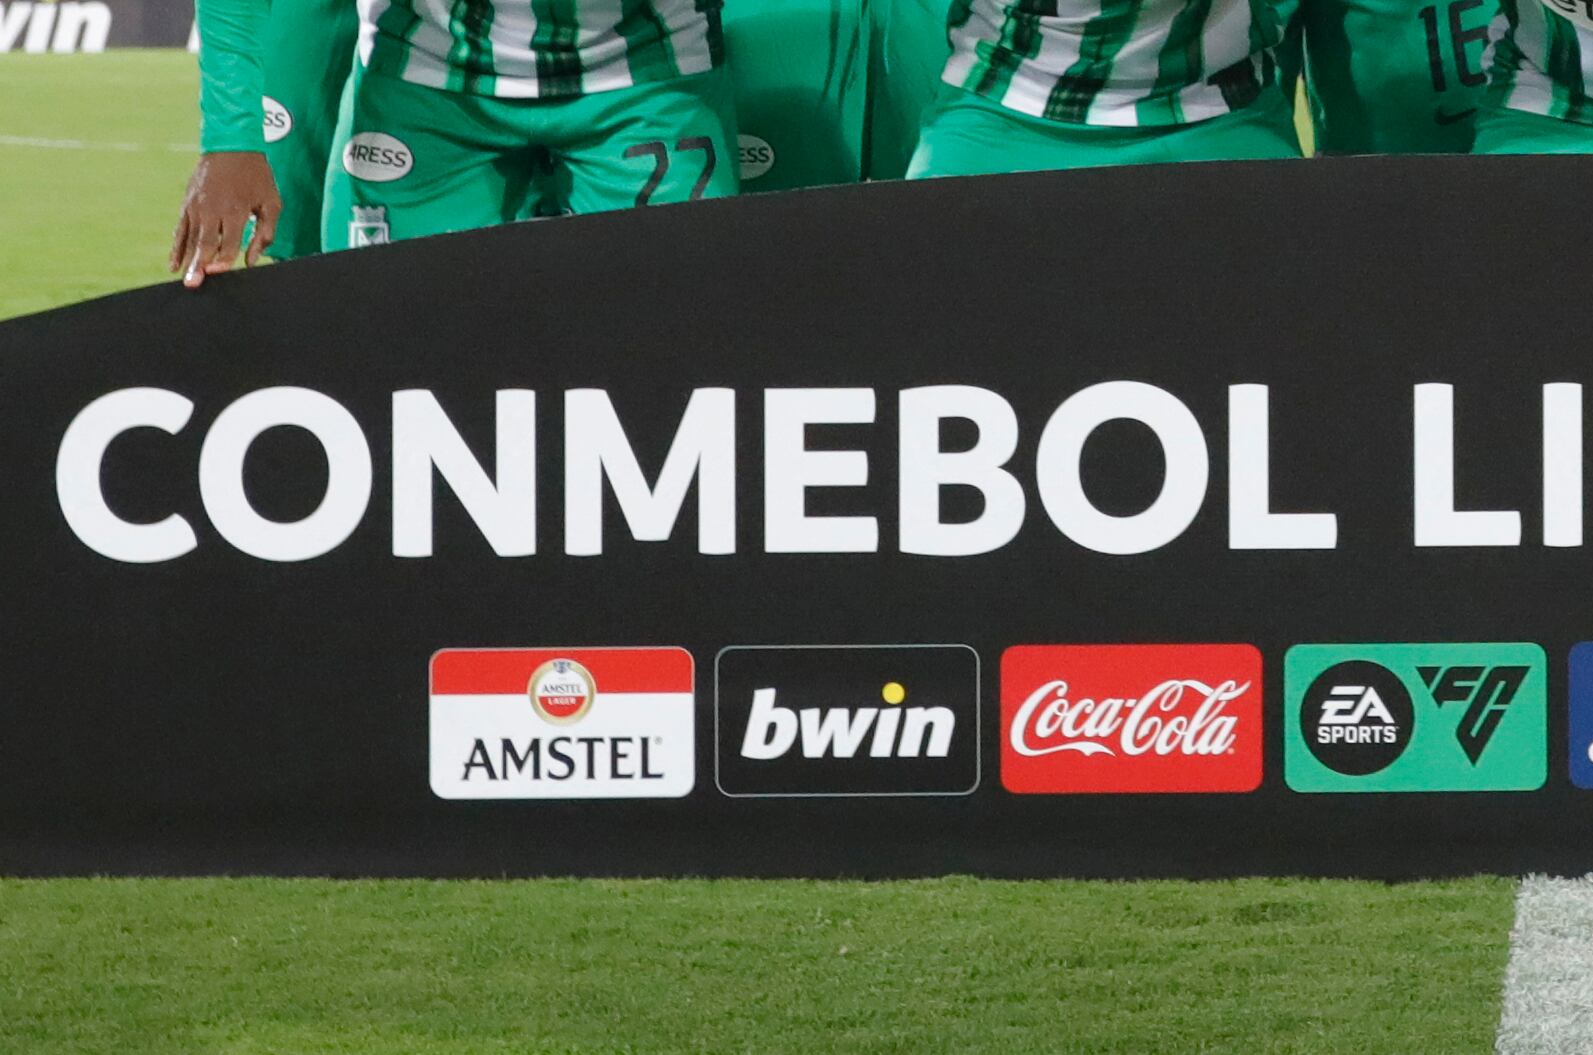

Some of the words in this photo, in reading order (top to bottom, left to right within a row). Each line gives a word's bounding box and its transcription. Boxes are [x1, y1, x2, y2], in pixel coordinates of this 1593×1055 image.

[349, 143, 407, 168] ARESS
[739, 145, 772, 165] ESS
[56, 381, 1337, 563] CONMEBOL
[741, 682, 955, 759] bwin
[1010, 680, 1250, 756] Coca-Cola
[1319, 685, 1396, 724] EA
[1317, 726, 1398, 744] SPORTS
[462, 736, 664, 780] AMSTEL
